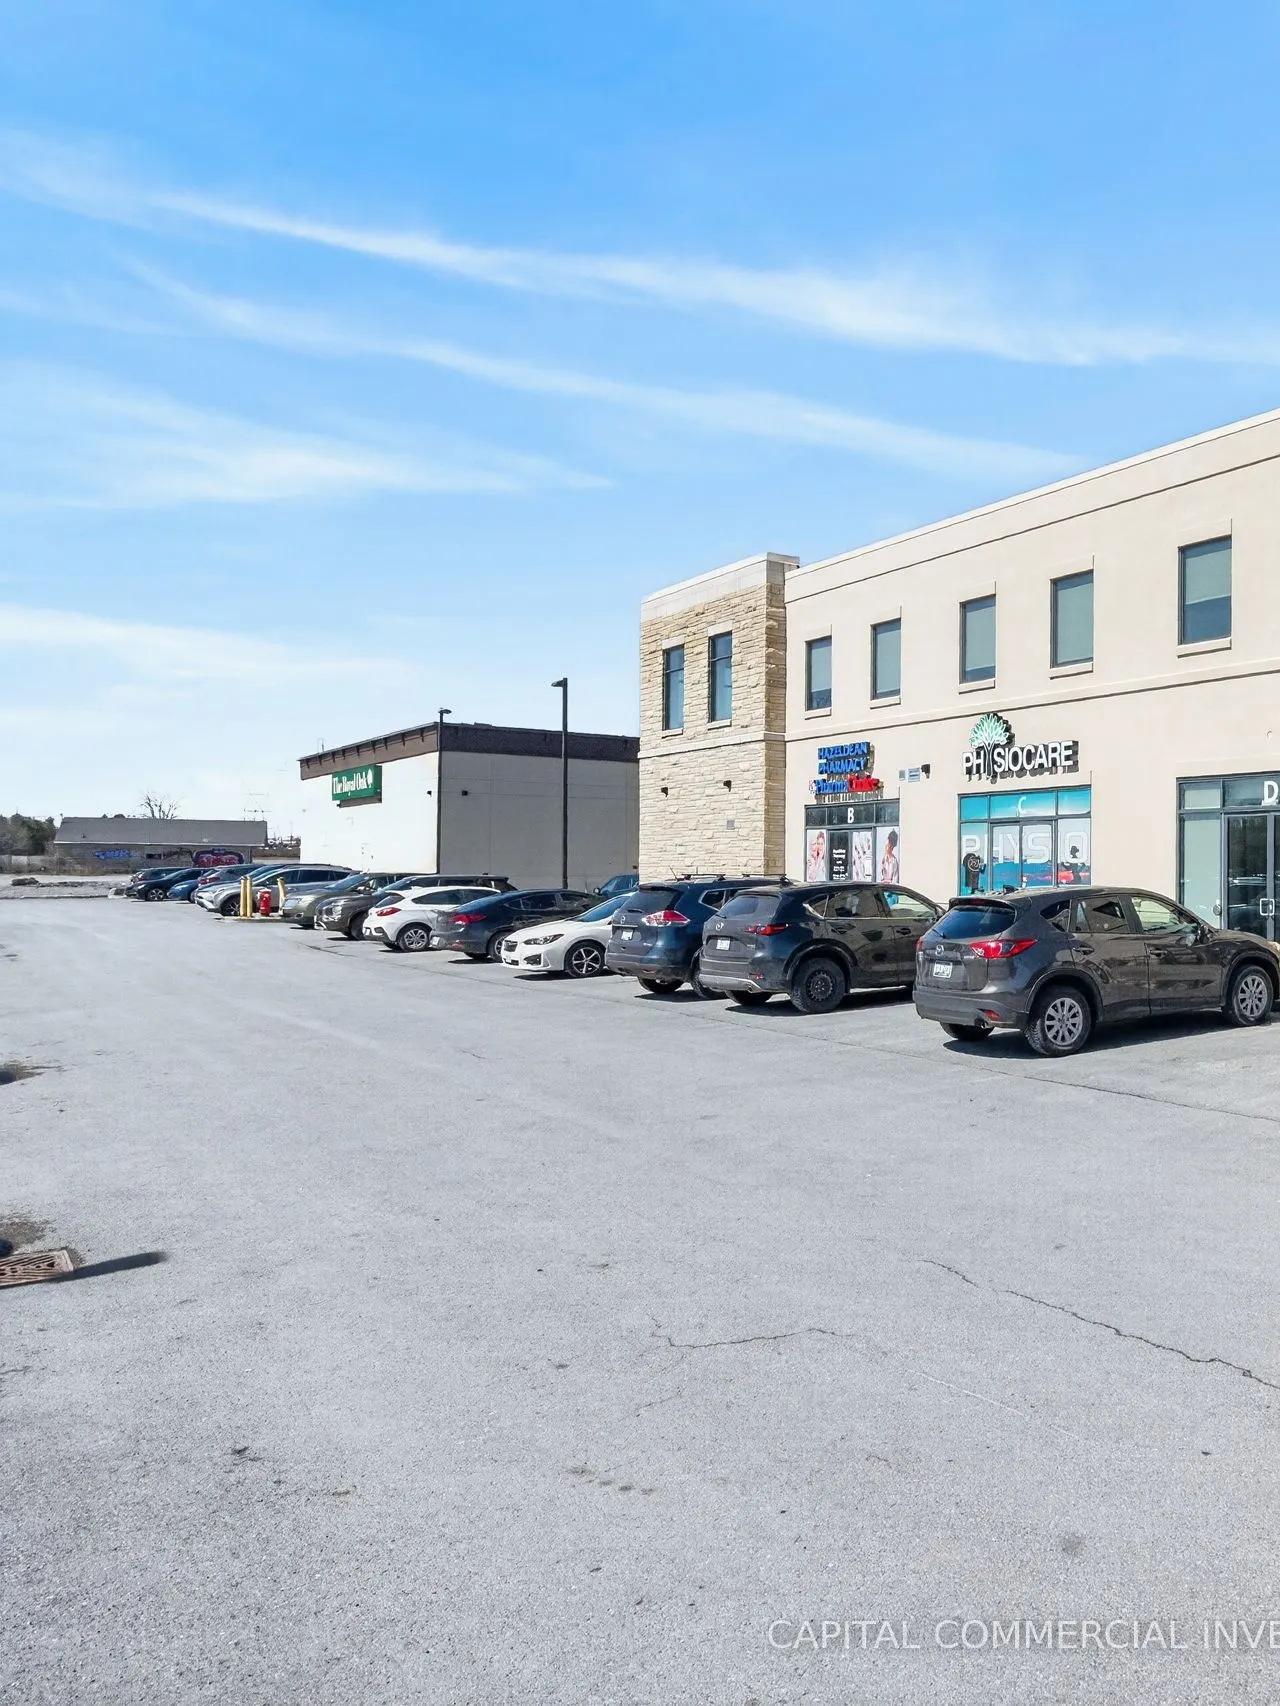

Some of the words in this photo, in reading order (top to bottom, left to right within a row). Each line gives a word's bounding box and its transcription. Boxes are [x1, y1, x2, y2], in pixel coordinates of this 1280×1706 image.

[962, 740, 1076, 777] PHYSIOCARE
[818, 760, 867, 775] PHARMACY
[1263, 781, 1279, 803] D
[1018, 796, 1027, 813] C
[847, 807, 855, 824] B
